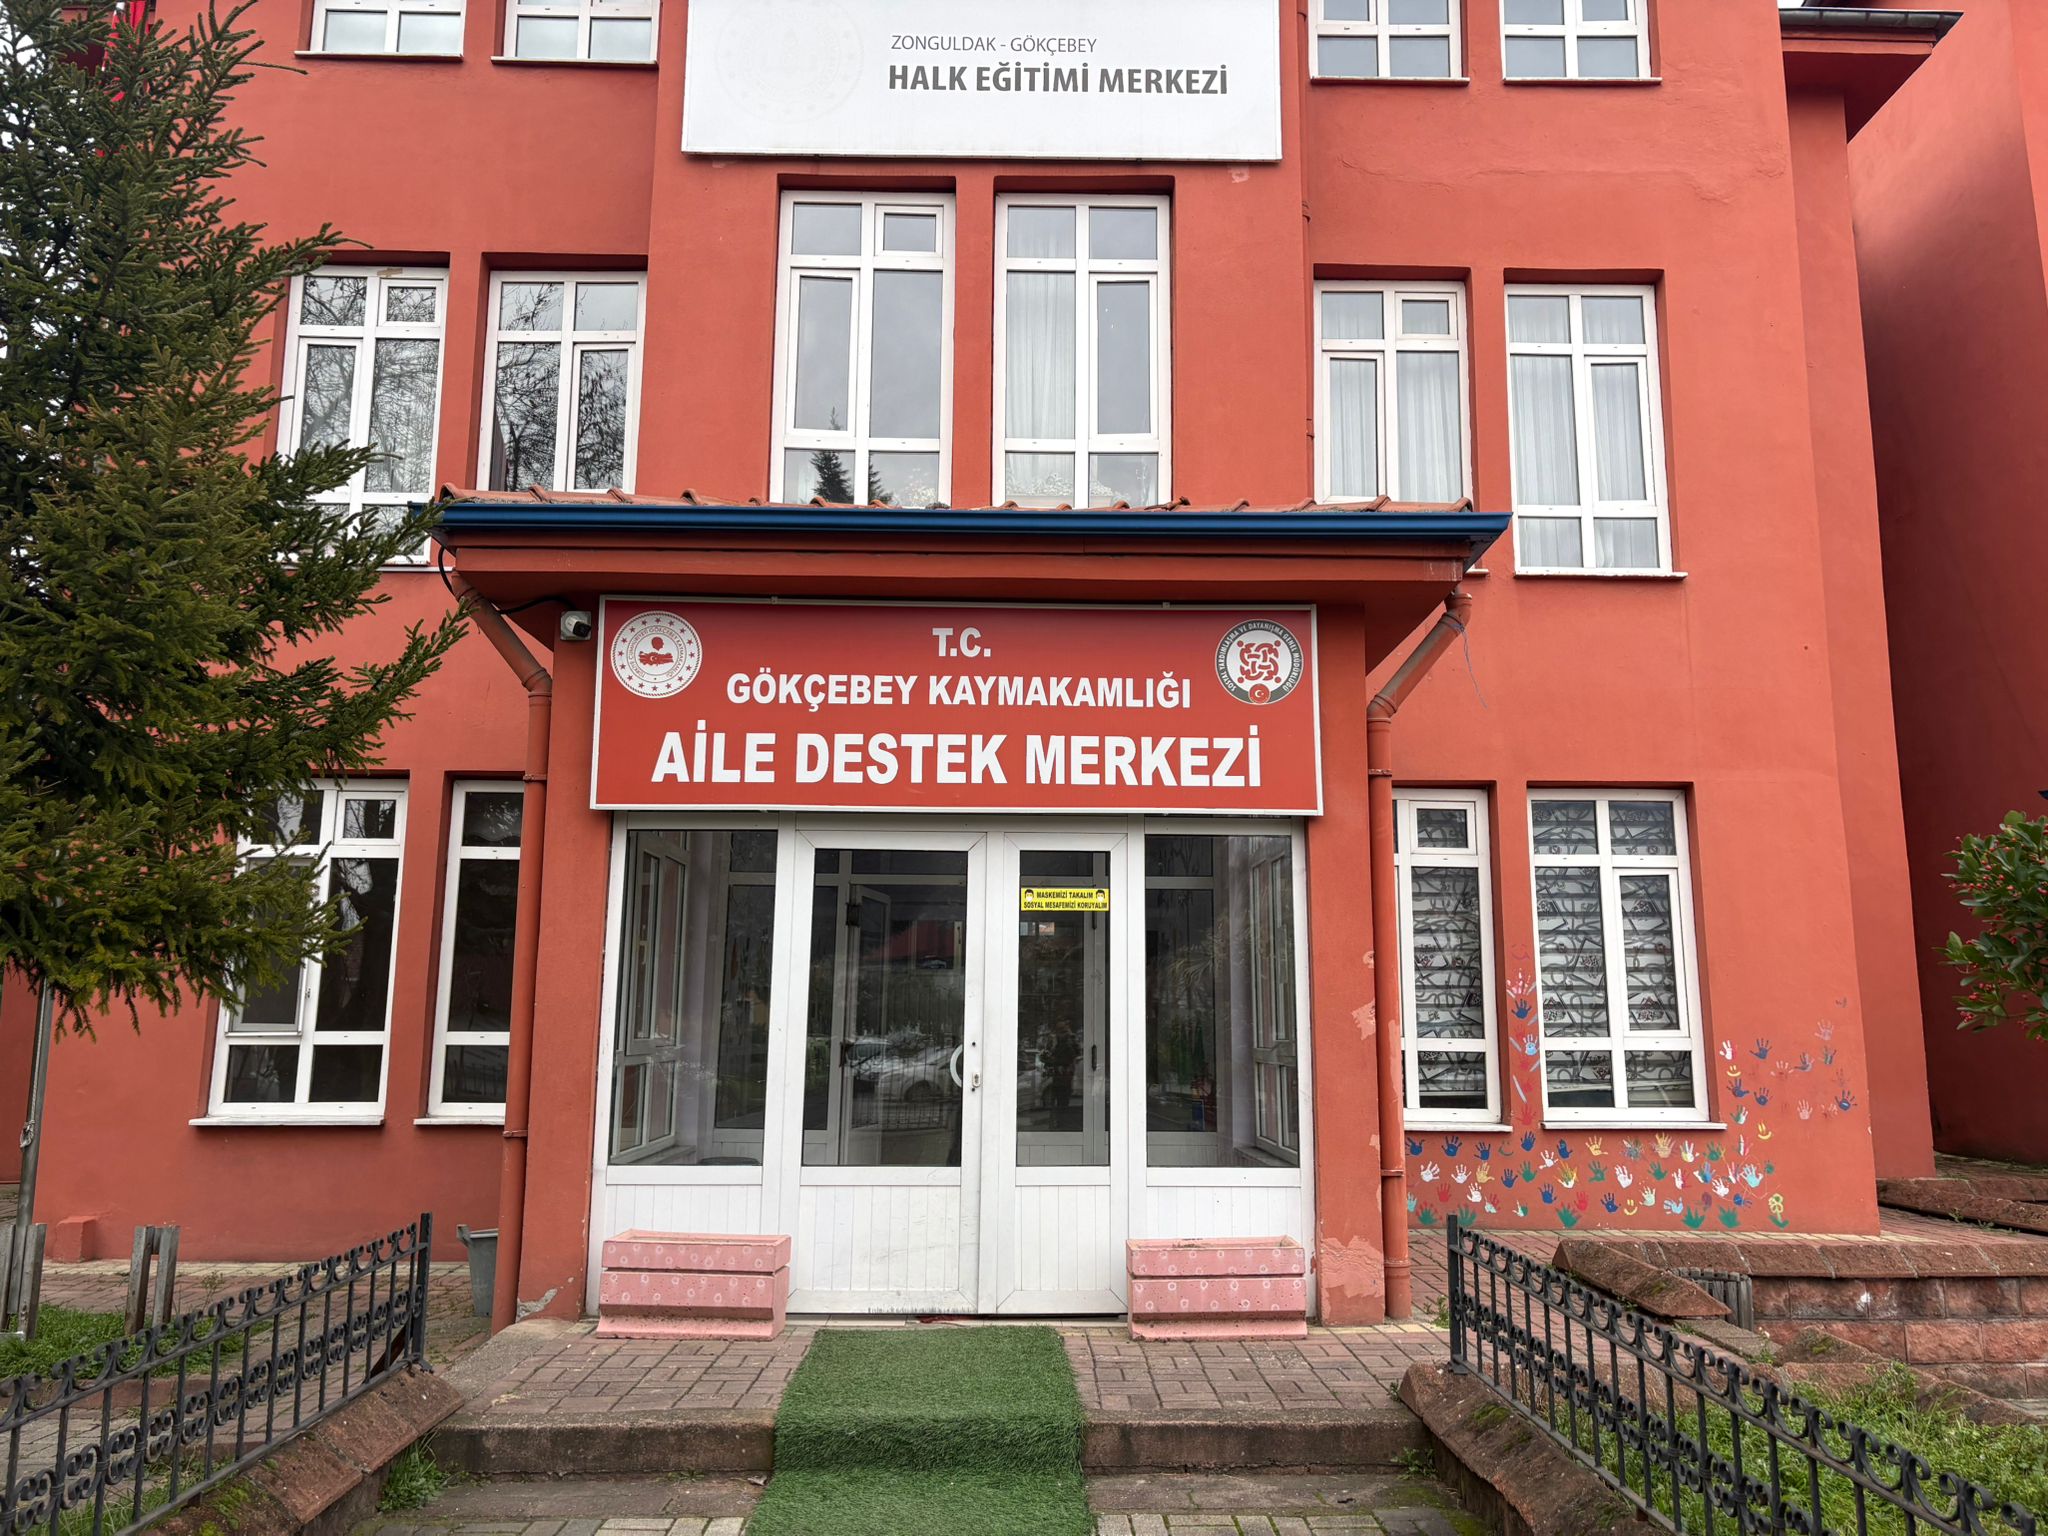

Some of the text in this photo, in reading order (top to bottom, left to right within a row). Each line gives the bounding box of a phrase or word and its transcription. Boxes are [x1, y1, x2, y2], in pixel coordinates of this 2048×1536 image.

[891, 35, 996, 53] ZONGULDAK
[1010, 35, 1098, 56] GÖKÇEBEY
[888, 61, 1228, 95] HALK EĞİTİMİ MERKEZİ
[932, 627, 992, 658] T.C.
[1218, 622, 1301, 692] SOSYAL YARDIMLAŞMA VE DAYANIŞMA GENEL MÜDÜRLÜĞÜ
[726, 667, 1191, 713] GÖKÇEBEY KAYMAKAMLIĞI
[651, 719, 1261, 787] AİLE DESTEK MERKEZİ
[1023, 900, 1108, 909] SOSYAL MESAFEMİZİ KORUYALIM
[1036, 890, 1094, 899] MASKEMİZİ TAKALIM
